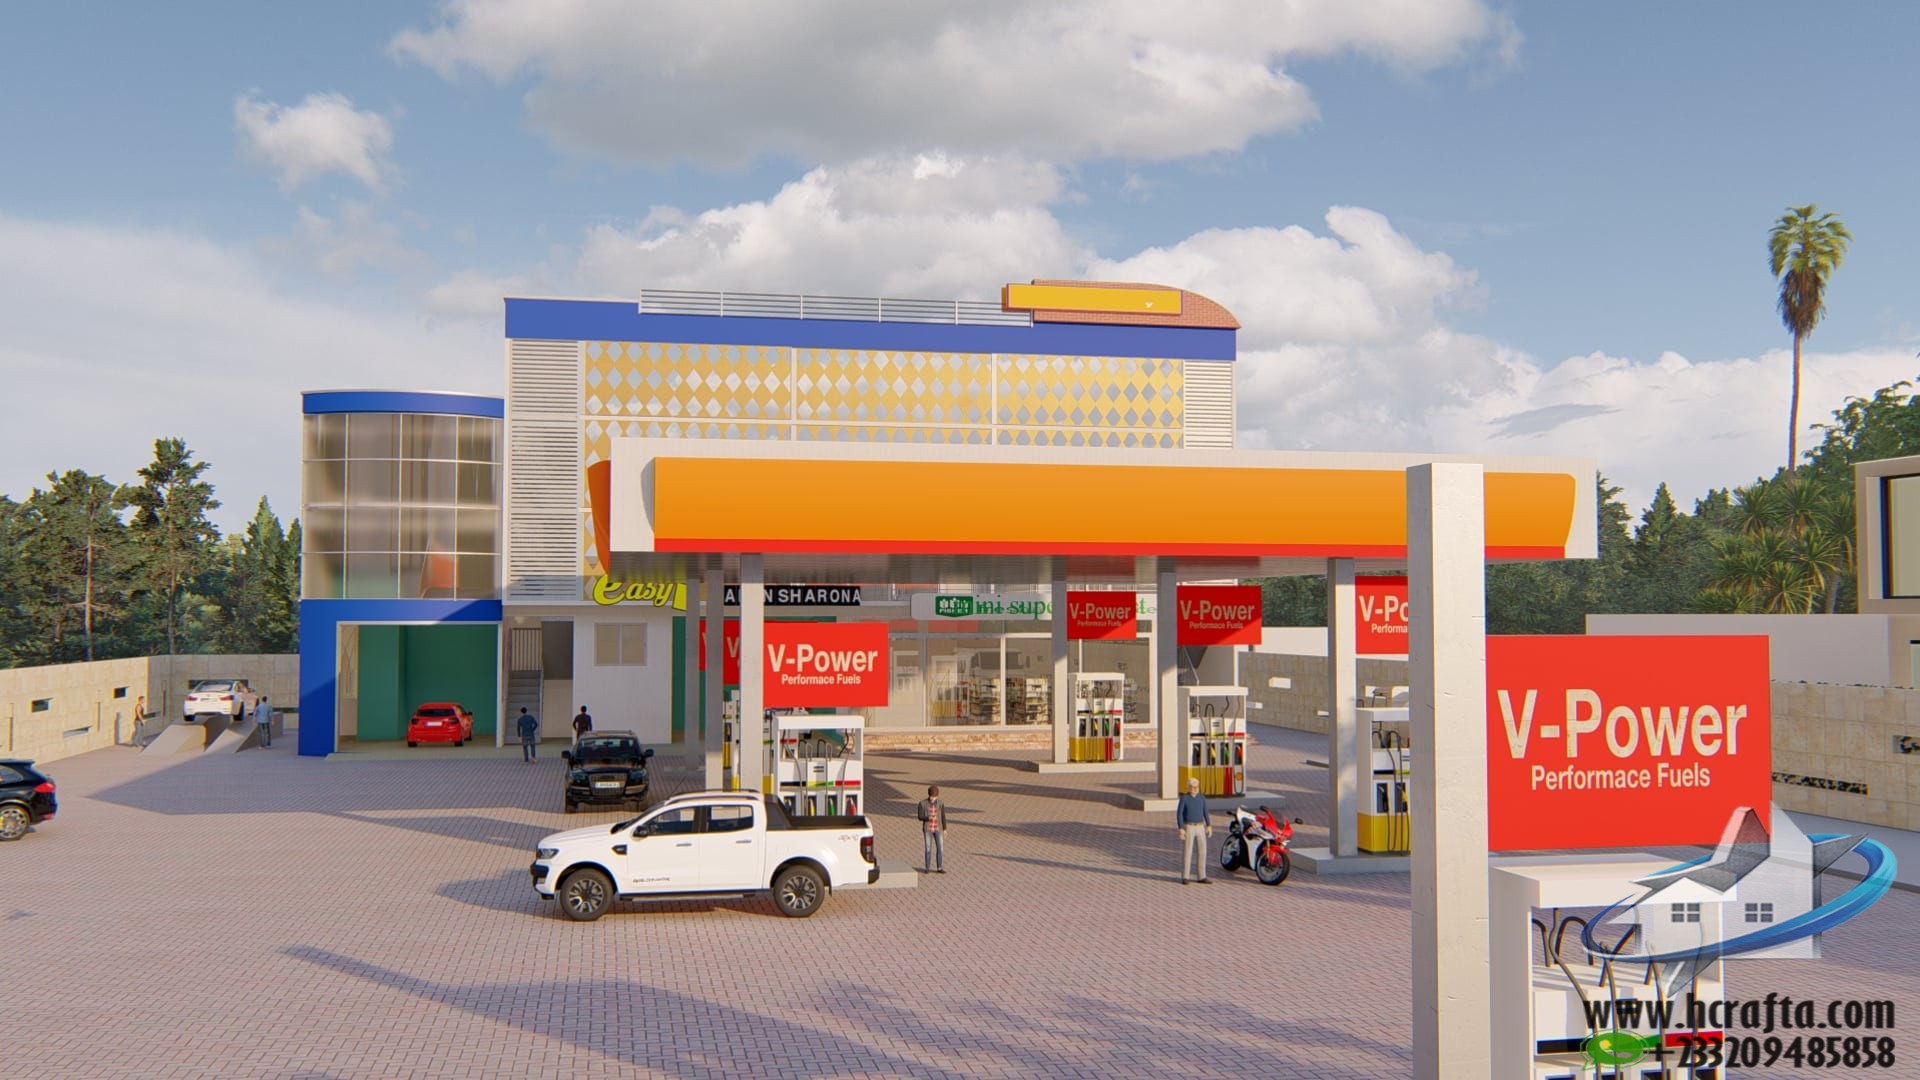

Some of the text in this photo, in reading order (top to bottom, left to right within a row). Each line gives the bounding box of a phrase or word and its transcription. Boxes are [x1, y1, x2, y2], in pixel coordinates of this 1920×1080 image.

[1069, 602, 1132, 620] V-Power
[1180, 600, 1255, 621] V-Power
[1226, 621, 1244, 630] Fuels
[767, 643, 878, 673] V-Power
[781, 673, 861, 685] Performace Fuels
[1497, 688, 1747, 759] V-Power
[1531, 762, 1711, 790] Performace Fuels
